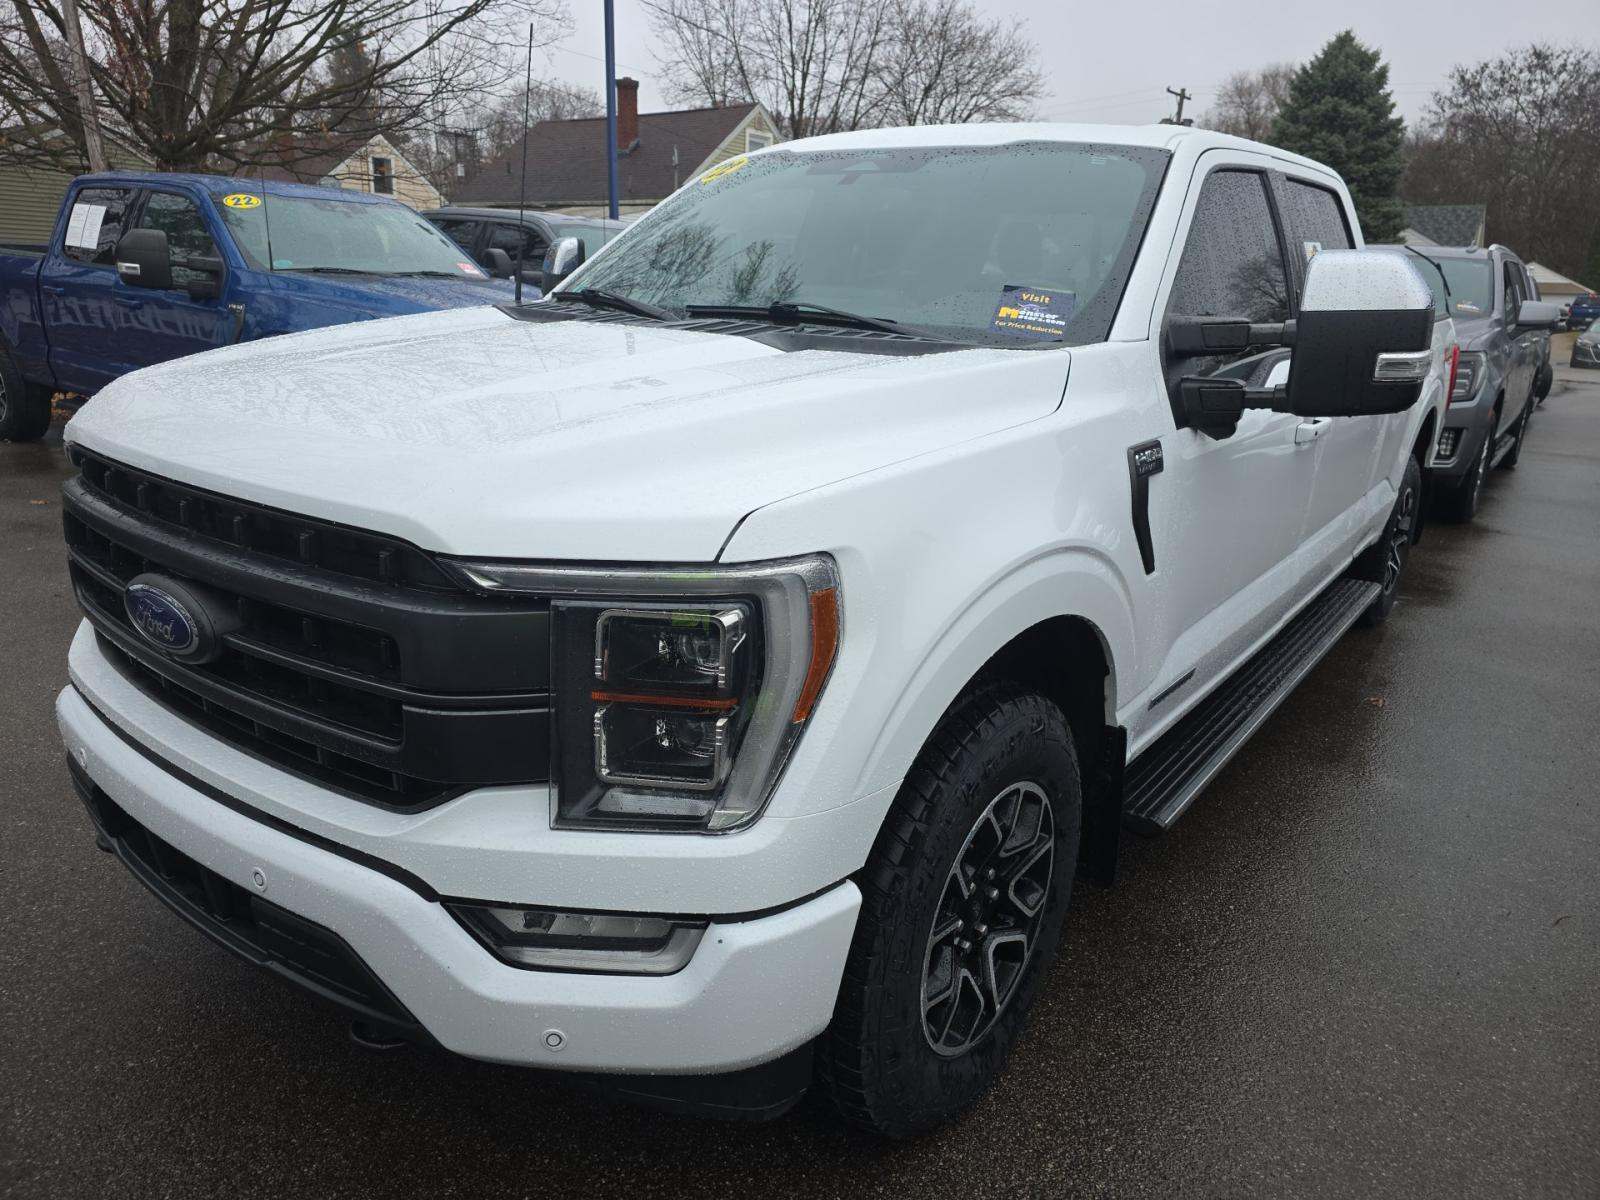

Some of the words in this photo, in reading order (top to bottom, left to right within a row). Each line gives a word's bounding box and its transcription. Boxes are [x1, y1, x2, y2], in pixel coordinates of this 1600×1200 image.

[1022, 293, 1051, 304] Visit
[1026, 325, 1063, 335] Reduction
[134, 598, 175, 641] Ford
